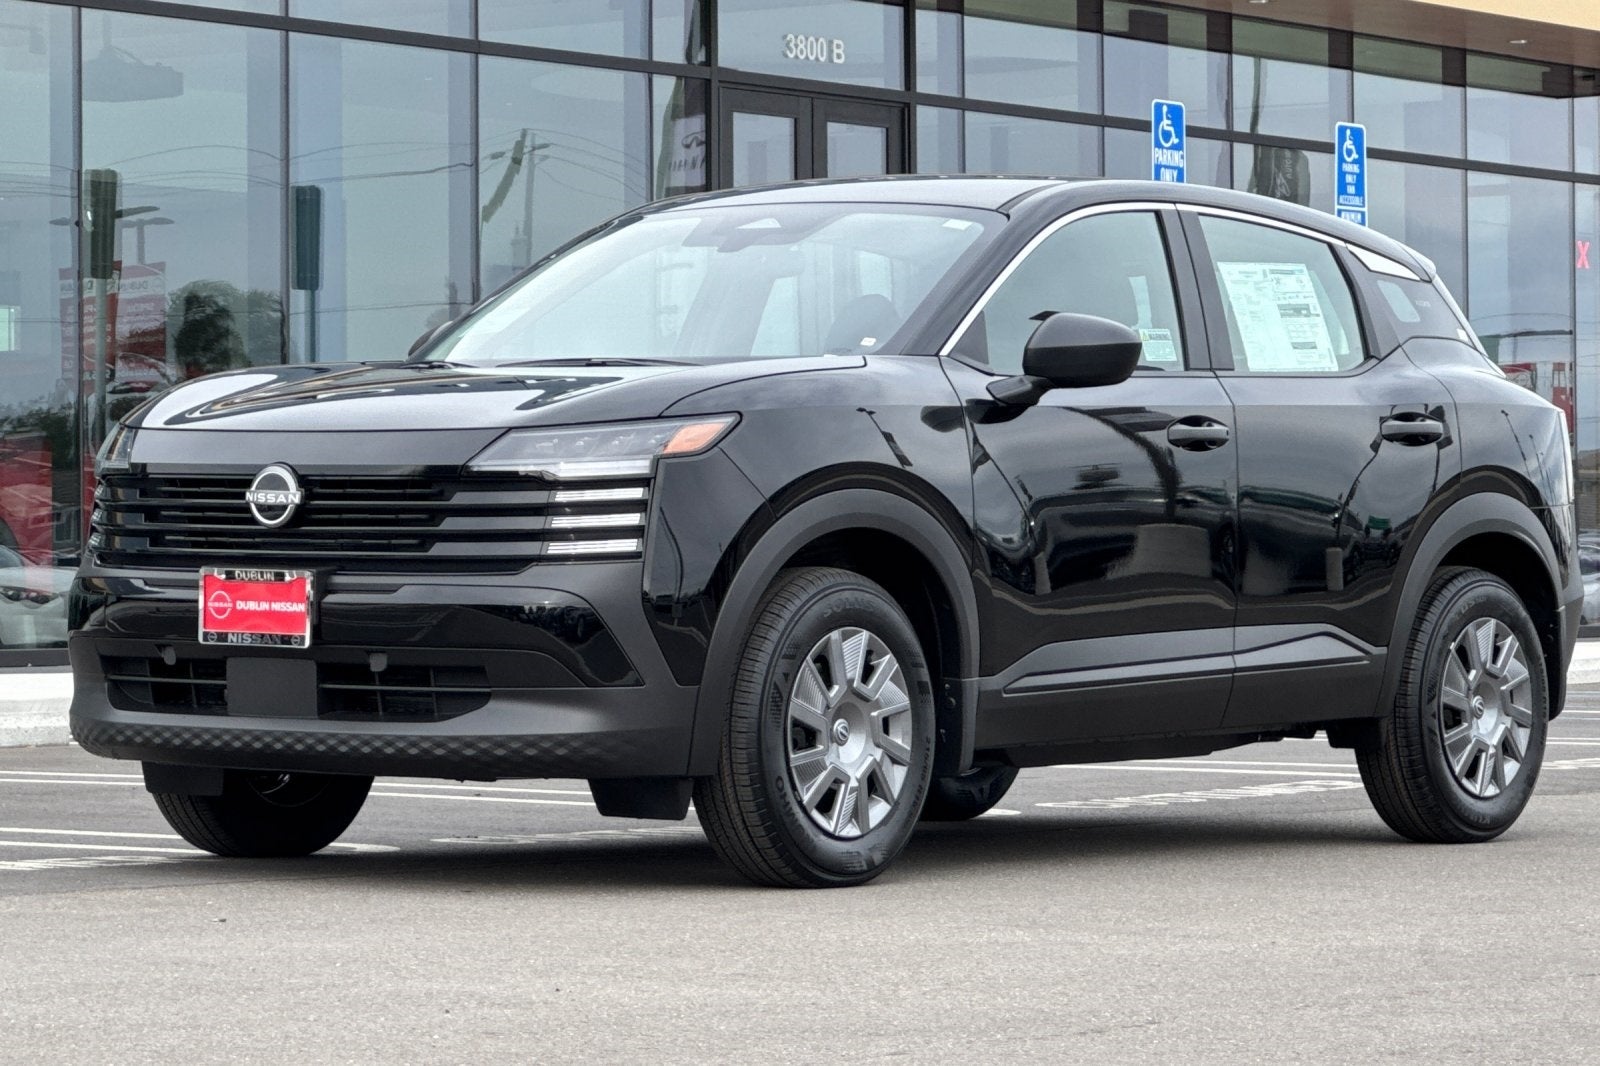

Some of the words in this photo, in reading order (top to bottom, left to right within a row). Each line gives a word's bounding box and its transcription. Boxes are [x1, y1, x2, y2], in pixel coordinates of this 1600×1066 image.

[784, 33, 827, 62] 3800
[833, 39, 845, 64] B
[1154, 147, 1184, 168] PARKING
[1342, 162, 1360, 174] PARKING
[1160, 167, 1178, 182] ONLY
[1345, 174, 1357, 184] ONLY
[245, 490, 300, 504] NISSAN
[234, 570, 275, 582] DUBLIN
[207, 600, 233, 608] NISSAN
[235, 600, 269, 611] DUBLIN
[271, 601, 306, 613] NISSAN
[227, 632, 282, 644] NISSAN
